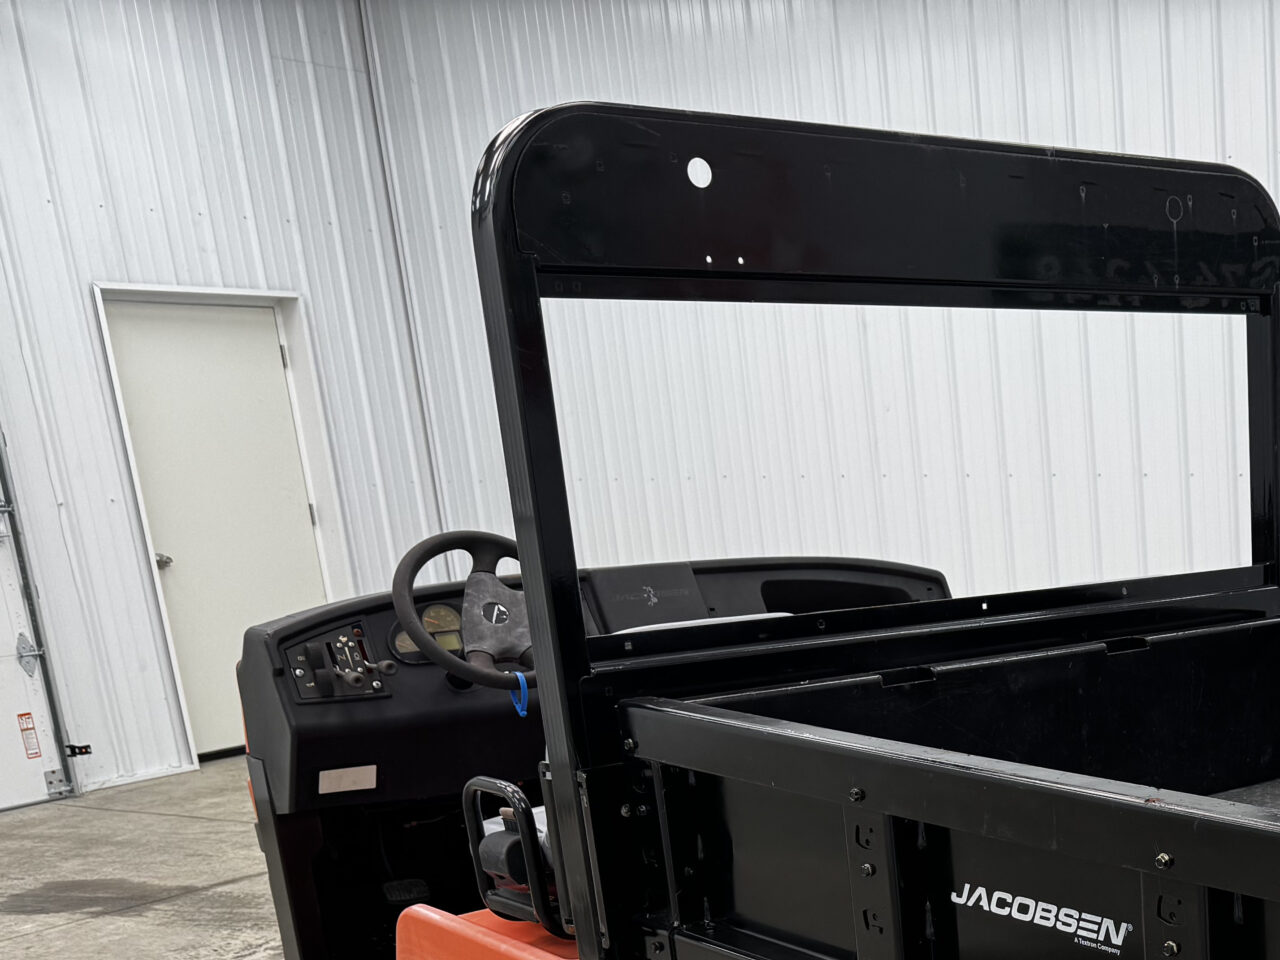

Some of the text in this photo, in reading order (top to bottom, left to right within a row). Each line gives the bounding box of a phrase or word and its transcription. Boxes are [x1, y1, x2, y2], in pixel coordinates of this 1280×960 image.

[951, 883, 1128, 946] JACOBSEN
[1079, 938, 1097, 949] Textron
[1098, 943, 1121, 956] Company
